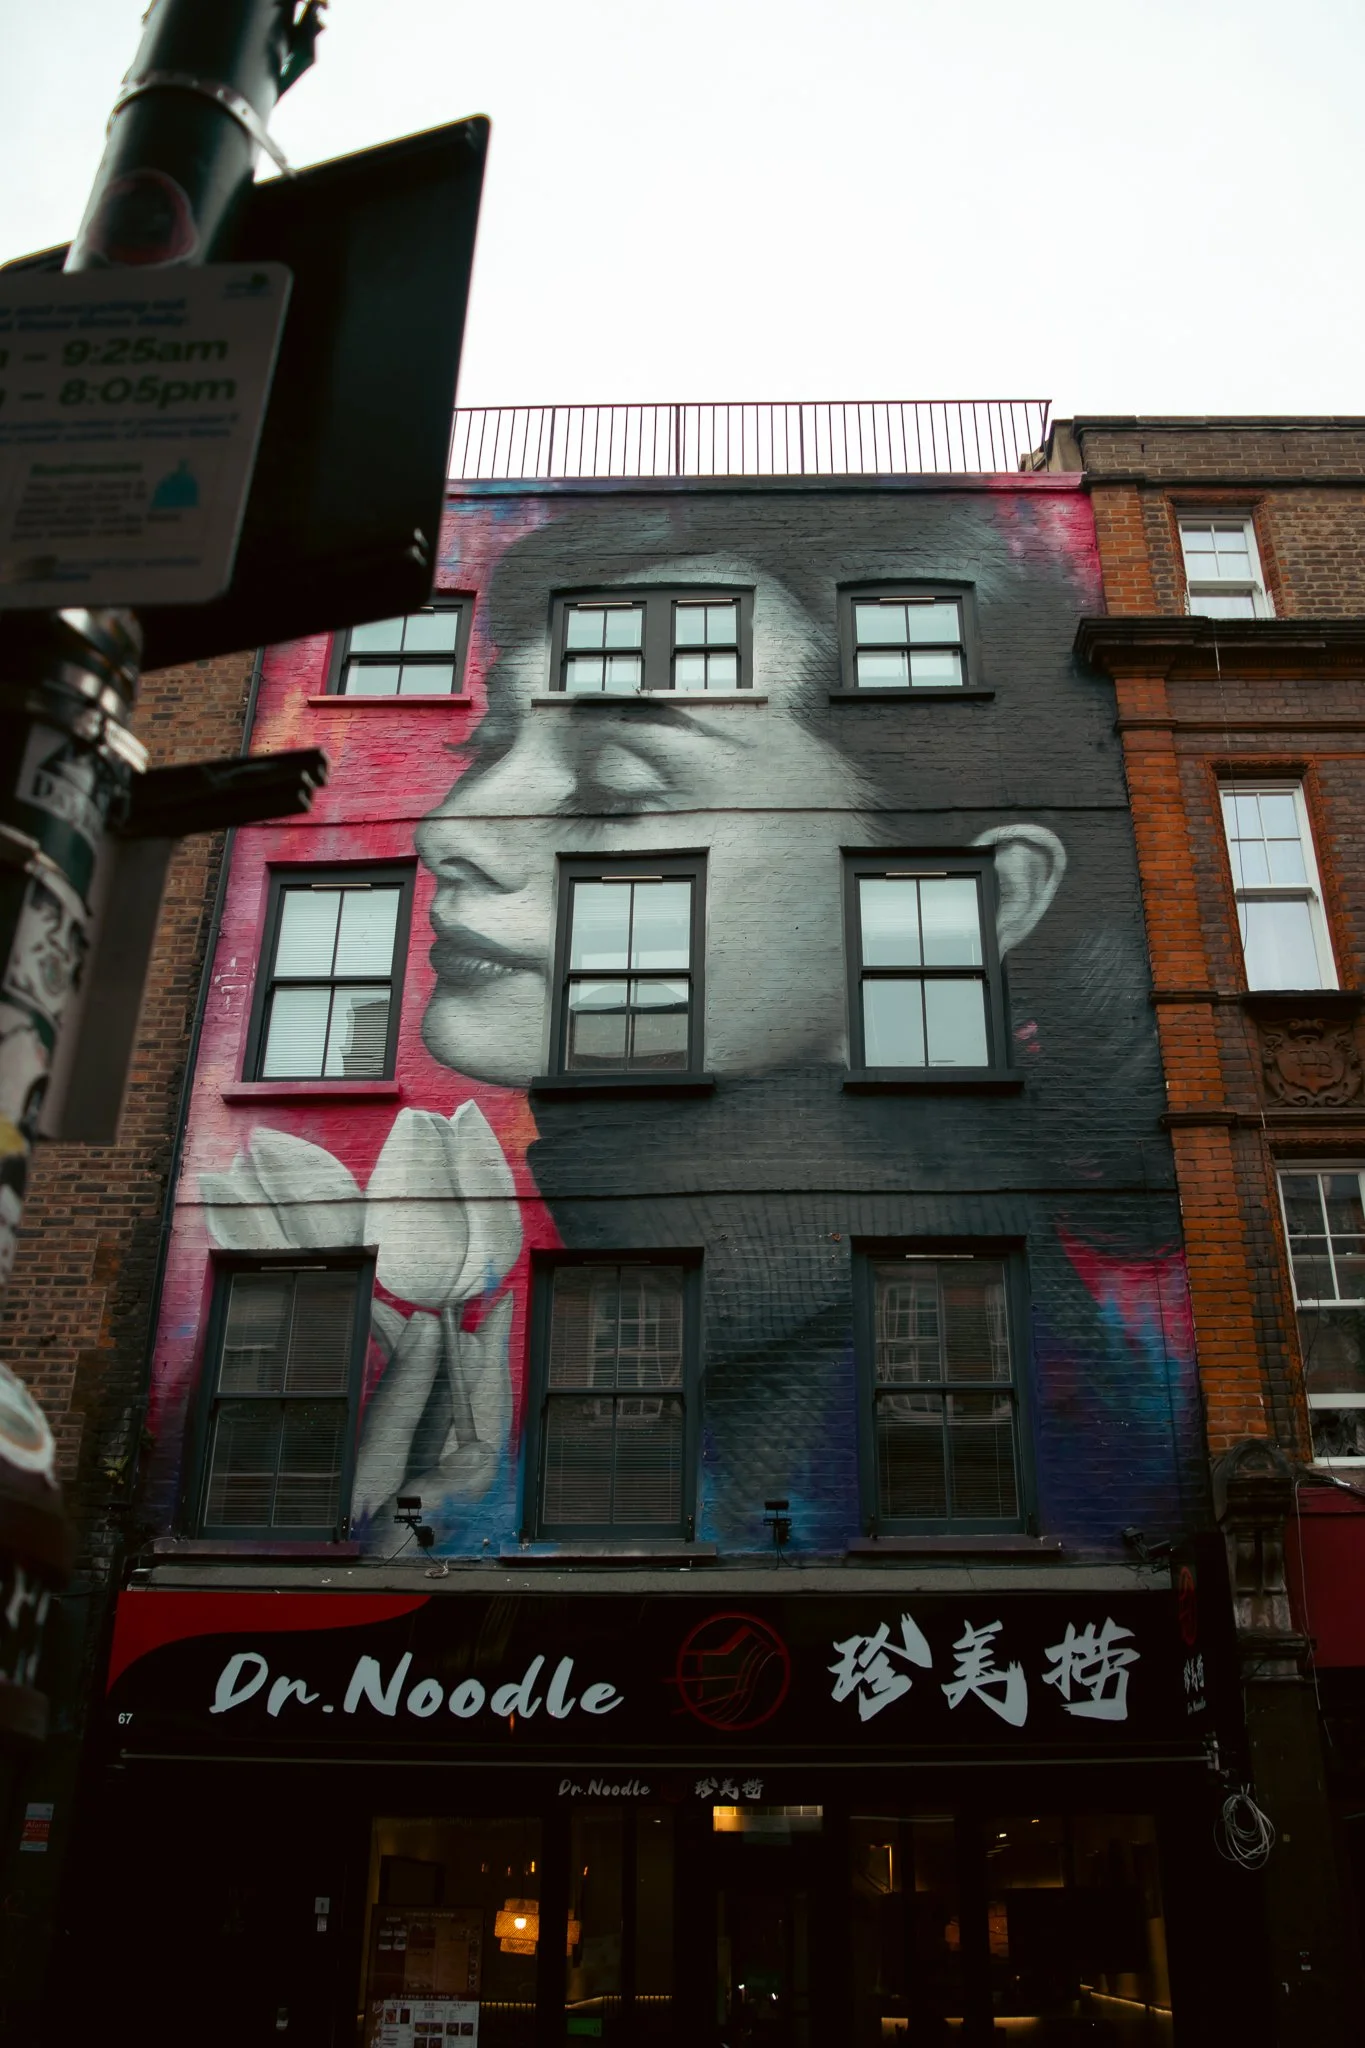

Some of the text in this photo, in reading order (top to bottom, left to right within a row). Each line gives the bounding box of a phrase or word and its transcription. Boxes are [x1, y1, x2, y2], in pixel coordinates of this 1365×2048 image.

[61, 336, 229, 367] 9:25am
[58, 373, 237, 409] 8:05pm
[117, 1712, 134, 1725] 67
